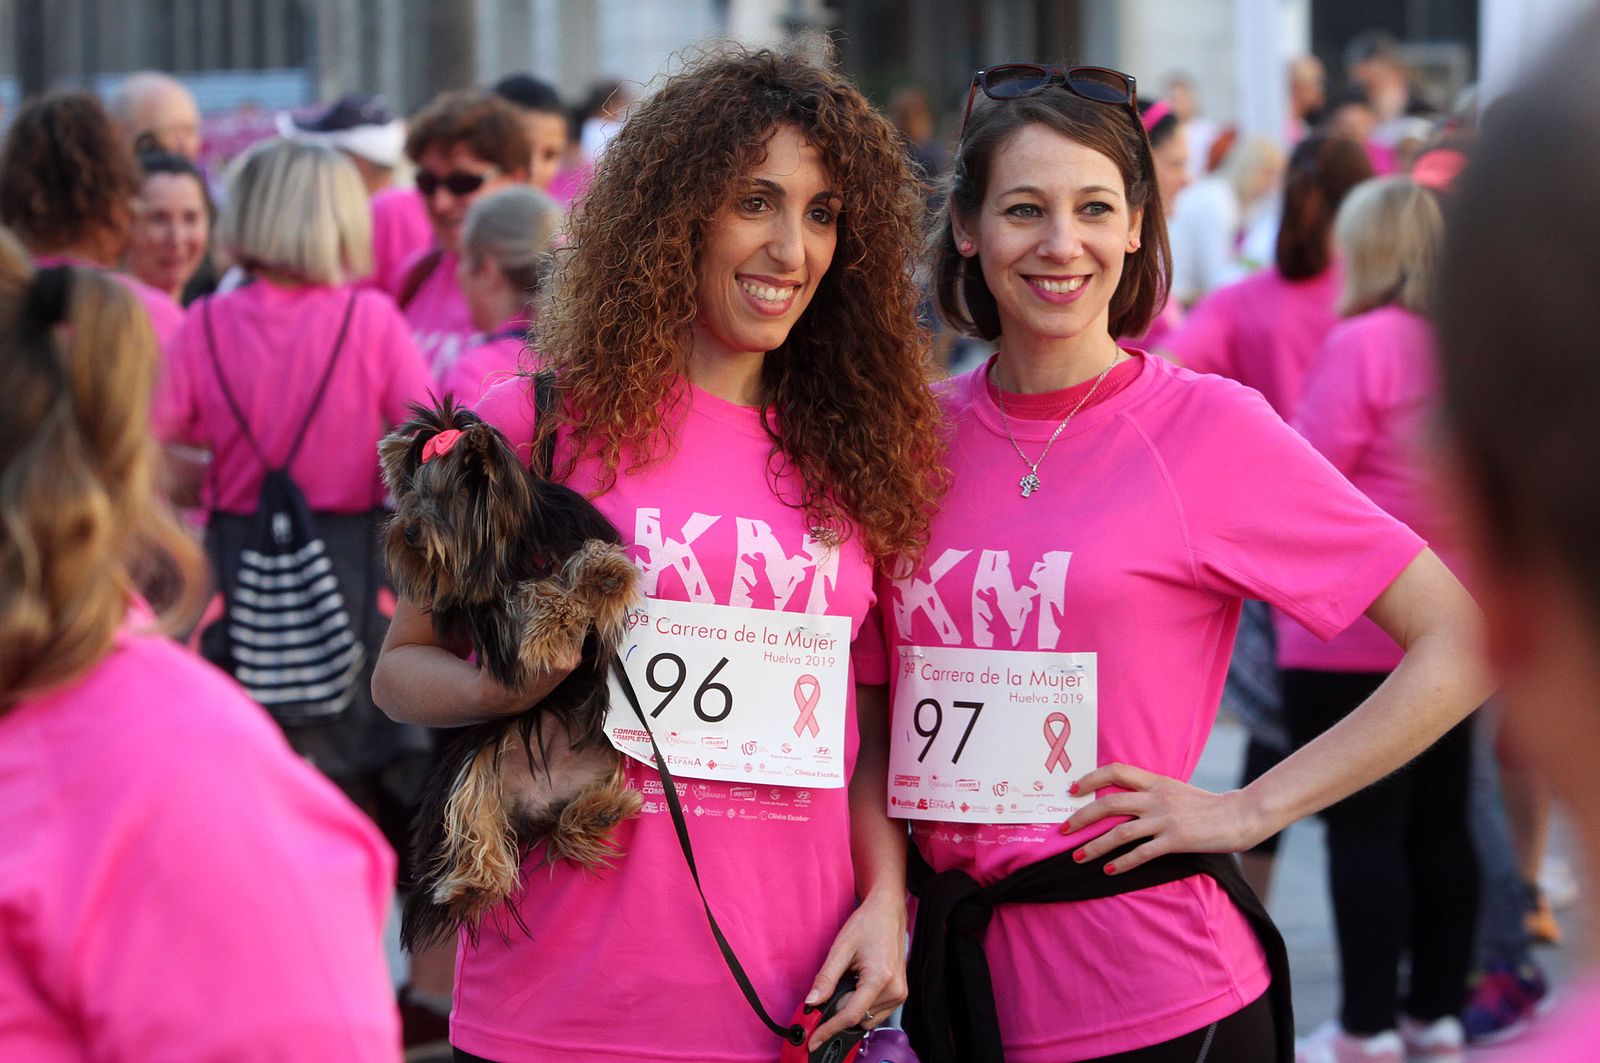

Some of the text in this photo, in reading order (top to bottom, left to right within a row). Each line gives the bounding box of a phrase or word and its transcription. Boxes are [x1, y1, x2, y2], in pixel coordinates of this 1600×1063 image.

[634, 507, 841, 616] KM
[891, 548, 1073, 650] KM
[655, 616, 728, 641] Carrera
[733, 624, 757, 644] de
[762, 627, 778, 646] la
[784, 630, 838, 654] Mujer
[763, 650, 836, 668] Huelva 2019
[645, 652, 733, 723] 96
[920, 663, 975, 683] Carrera
[980, 666, 1000, 685] de
[1006, 668, 1022, 686] la
[1029, 671, 1084, 691] Mujer
[1008, 692, 1084, 705] Huelva 2019
[913, 698, 985, 765] 97
